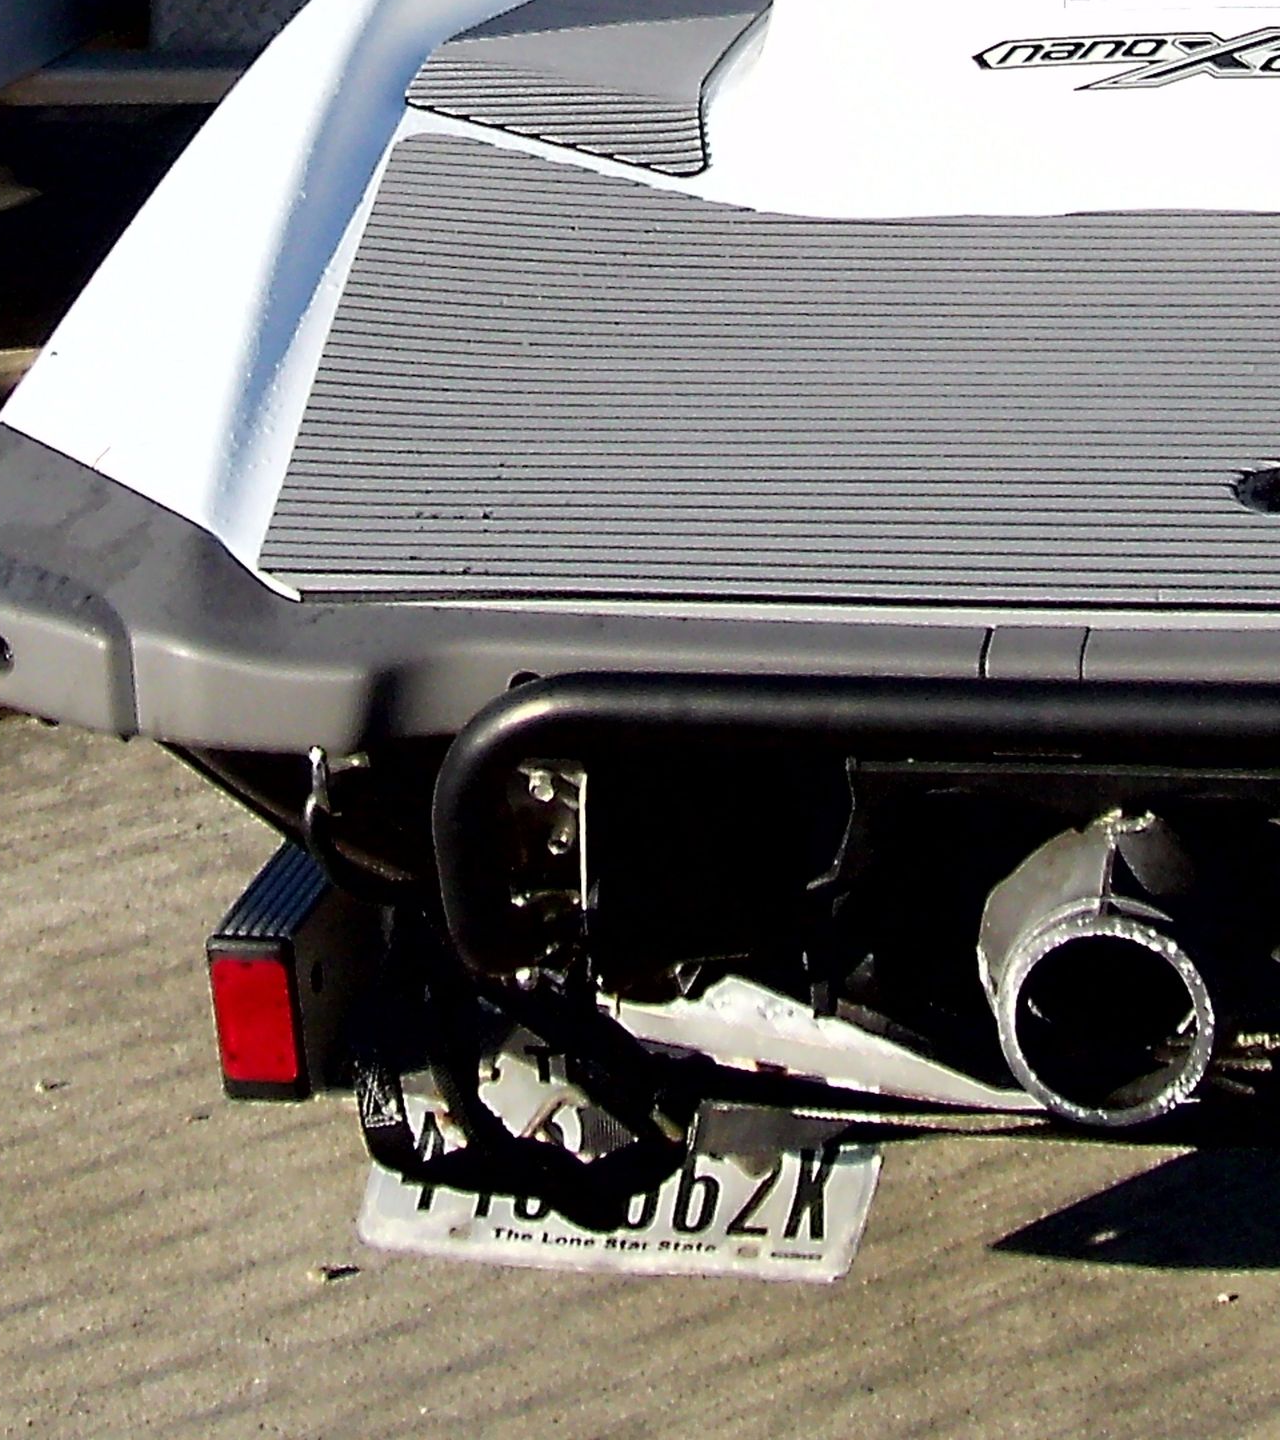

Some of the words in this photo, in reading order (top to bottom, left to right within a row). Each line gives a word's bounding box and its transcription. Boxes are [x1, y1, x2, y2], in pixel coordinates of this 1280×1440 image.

[492, 1227, 534, 1241] The
[541, 1231, 595, 1248] Lone
[604, 1239, 648, 1252] Star
[657, 1241, 717, 1253] State
